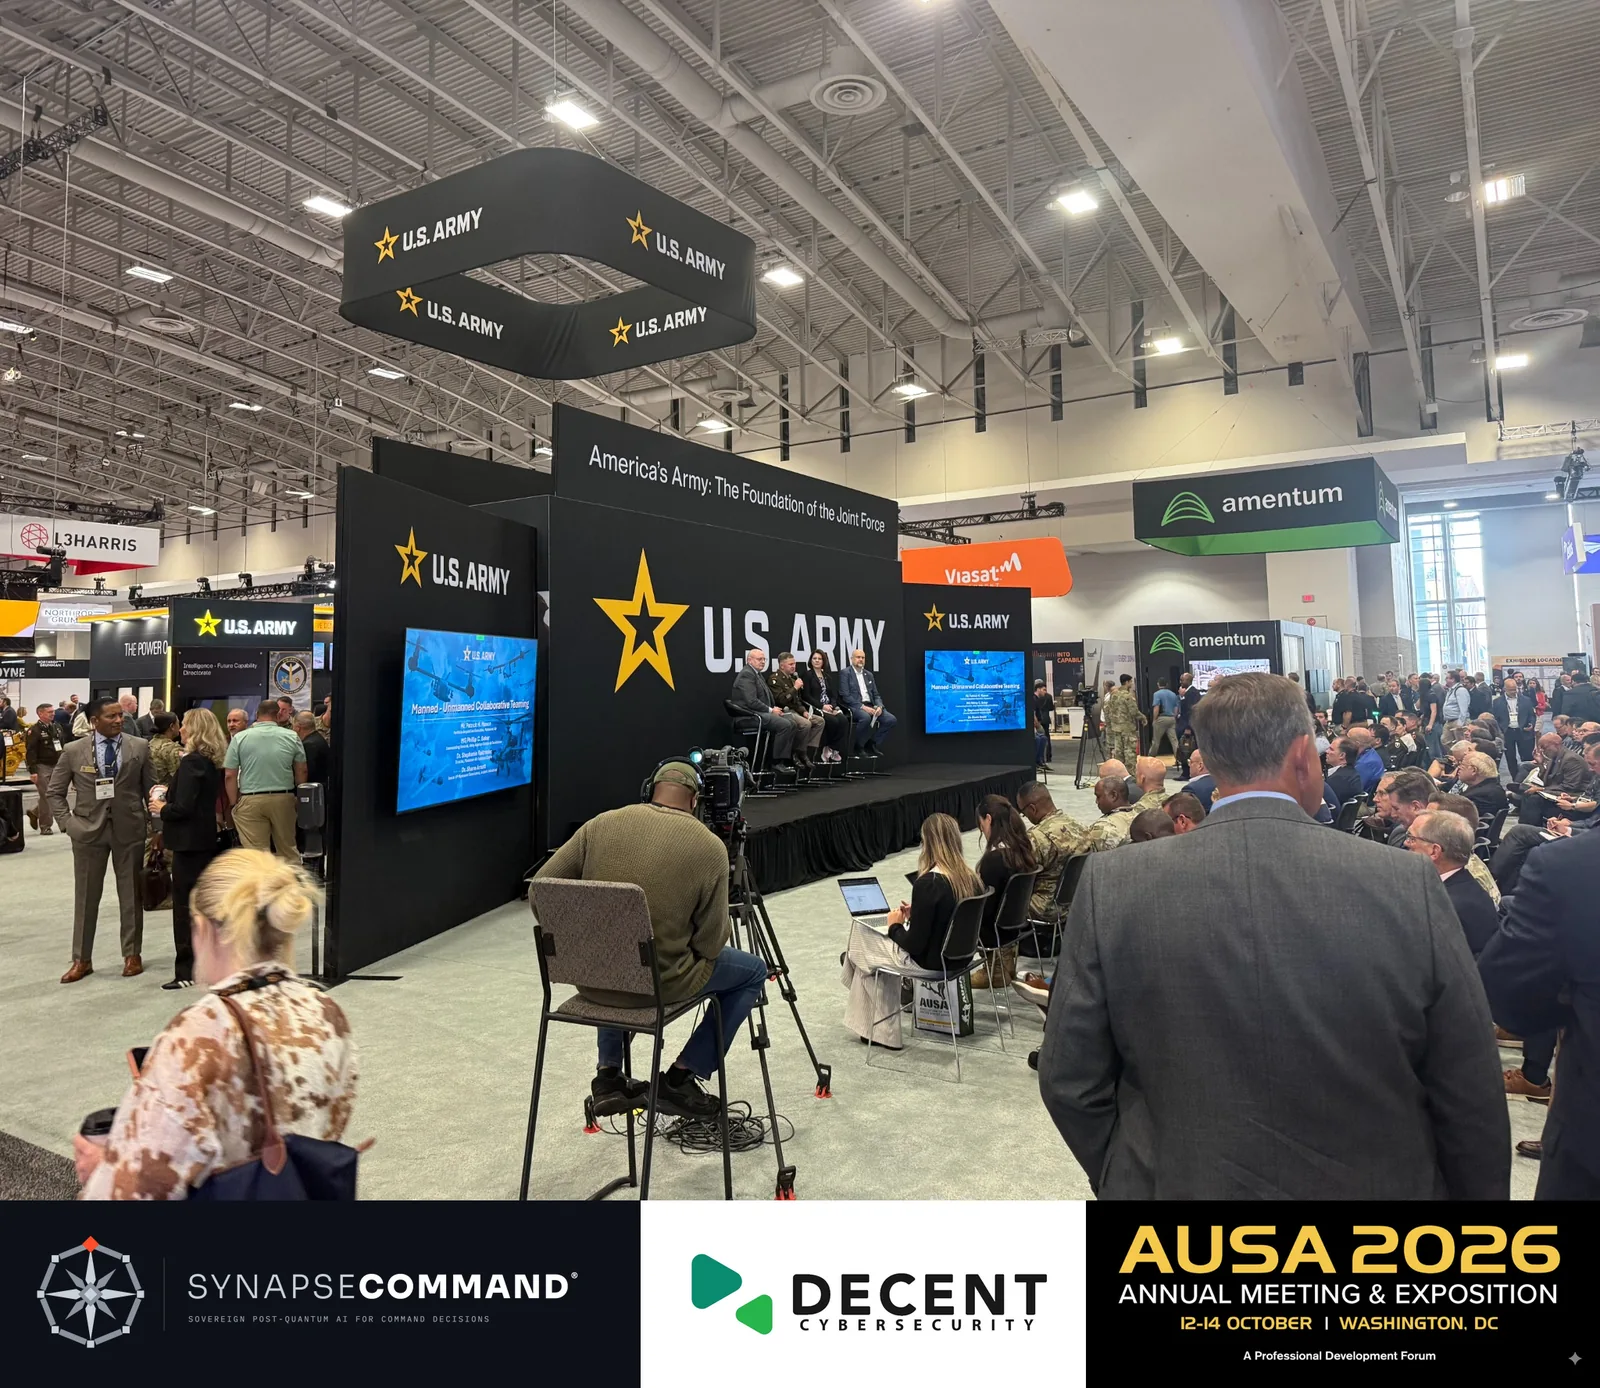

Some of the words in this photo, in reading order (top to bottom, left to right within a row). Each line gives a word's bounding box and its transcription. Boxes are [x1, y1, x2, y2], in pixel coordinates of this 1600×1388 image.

[403, 225, 431, 252] U.S.
[433, 206, 483, 242] ARMY
[656, 231, 683, 263] U.S.
[685, 247, 726, 280] ARMY
[427, 300, 456, 326] U.S.
[458, 311, 504, 340] ARMY
[635, 317, 662, 338] U.S.
[664, 306, 708, 332] ARMY
[588, 444, 668, 484] America's
[671, 466, 712, 497] Army:
[714, 475, 739, 500] The
[742, 482, 805, 515] Foundation
[806, 501, 818, 517] of
[818, 503, 835, 521] the
[836, 506, 859, 527] Joint
[860, 513, 885, 533] Force
[1222, 486, 1343, 513] amentum
[54, 532, 137, 552] L3HARRIS
[432, 553, 463, 588] U.S.
[466, 561, 511, 596] ARMY
[945, 566, 1000, 585] Viasat
[44, 609, 93, 617] NORTHROP
[948, 613, 972, 629] U.S.
[973, 614, 1010, 629] ARMY
[224, 619, 251, 635] U.S.
[253, 620, 298, 636] ARMY
[124, 642, 137, 657] THE
[138, 640, 163, 656] POWER
[704, 606, 778, 673] U.S.
[790, 613, 886, 673] ARMY
[1189, 633, 1266, 647] amentum
[482, 651, 496, 661] ARMY
[411, 703, 438, 715] Manned
[443, 701, 475, 713] Unmanned
[475, 699, 510, 711] Collaborative
[510, 699, 530, 711] Teaming
[919, 998, 949, 1010] AUSA
